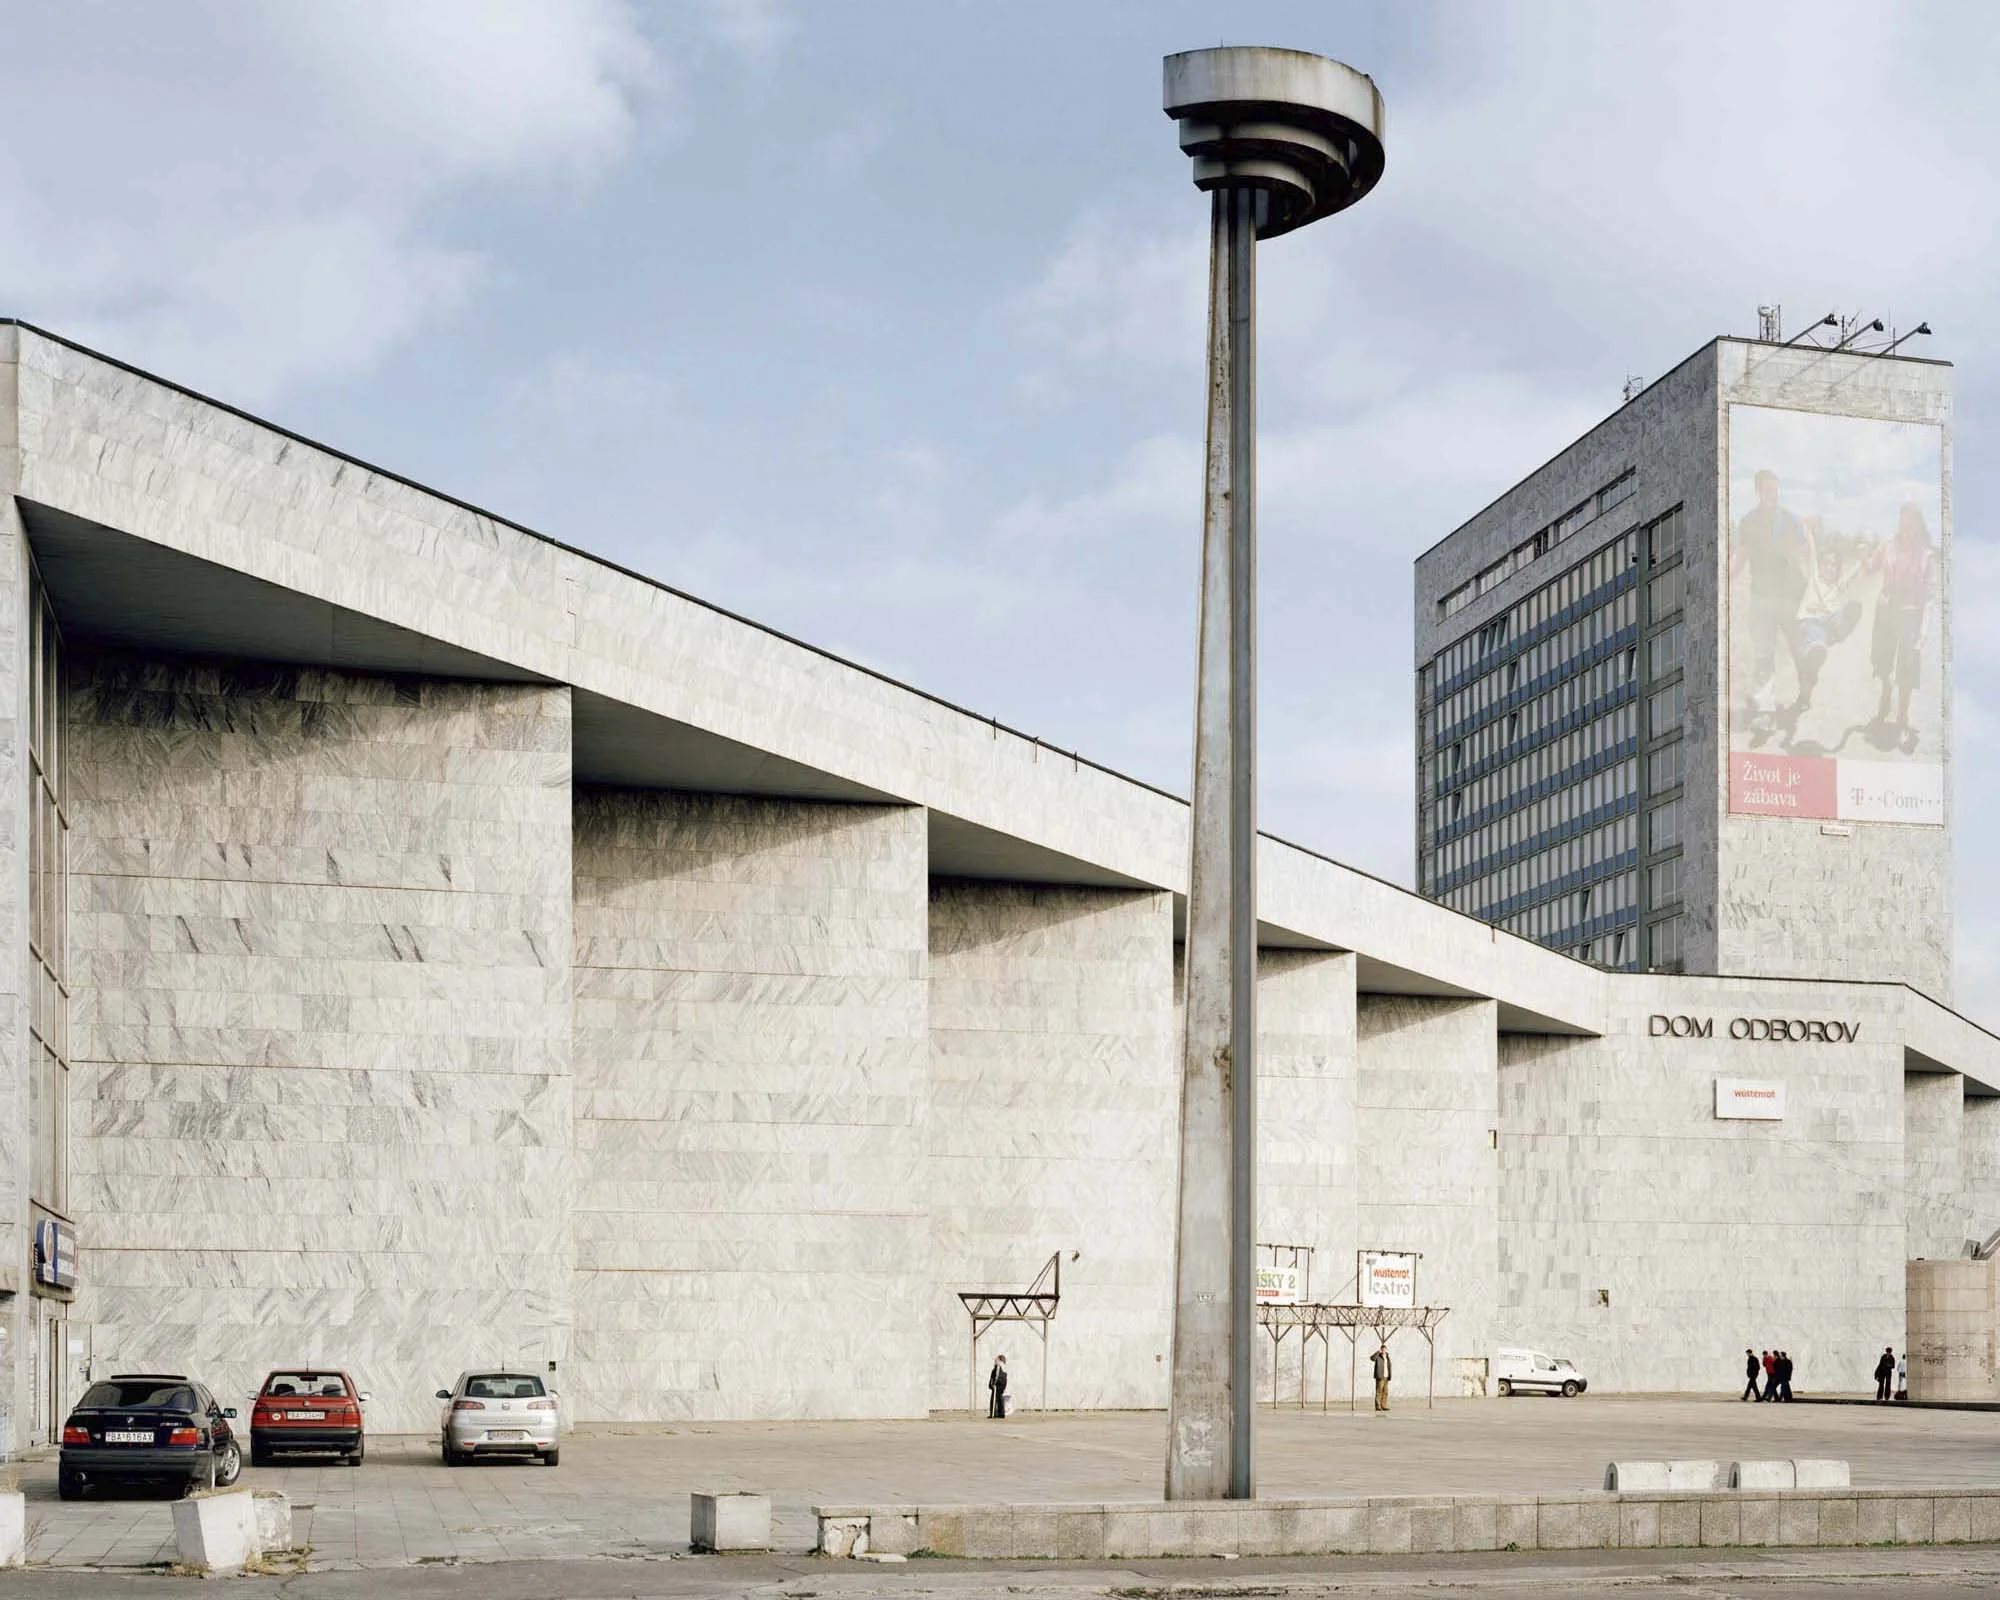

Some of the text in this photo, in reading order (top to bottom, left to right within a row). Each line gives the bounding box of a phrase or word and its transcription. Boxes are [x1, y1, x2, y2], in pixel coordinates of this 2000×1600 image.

[1743, 759, 1801, 787] Život je
[1743, 788, 1797, 807] zábava
[1649, 1014, 1861, 1043] DOM ODBOROV
[1288, 1274, 1296, 1289] 2
